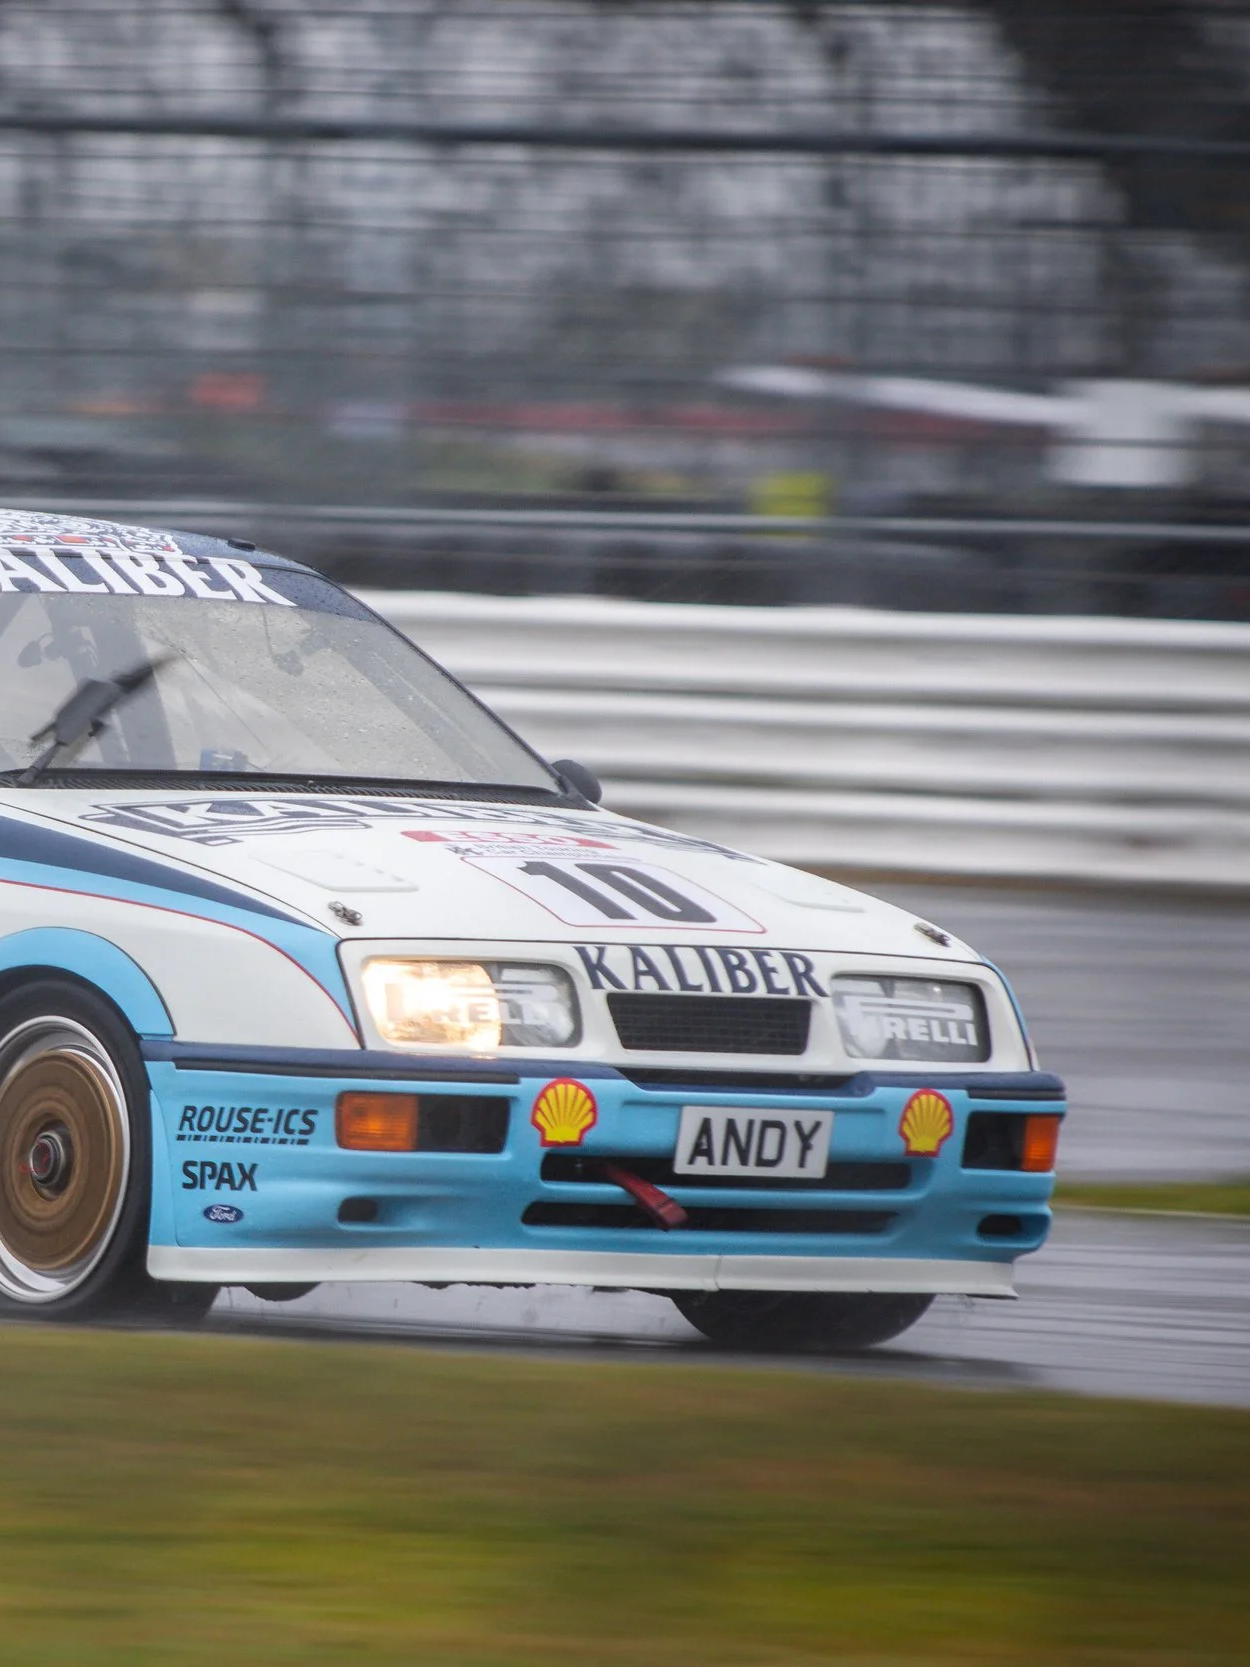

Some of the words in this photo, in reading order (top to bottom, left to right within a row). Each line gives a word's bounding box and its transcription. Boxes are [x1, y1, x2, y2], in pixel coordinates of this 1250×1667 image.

[432, 831, 581, 846] ESSO
[516, 861, 718, 923] 10
[571, 944, 831, 998] KALIBER
[178, 1105, 319, 1136] ROUSE-ICS
[687, 1117, 823, 1168] ANDY
[181, 1160, 259, 1191] SPAX
[210, 1206, 237, 1222] Ford
